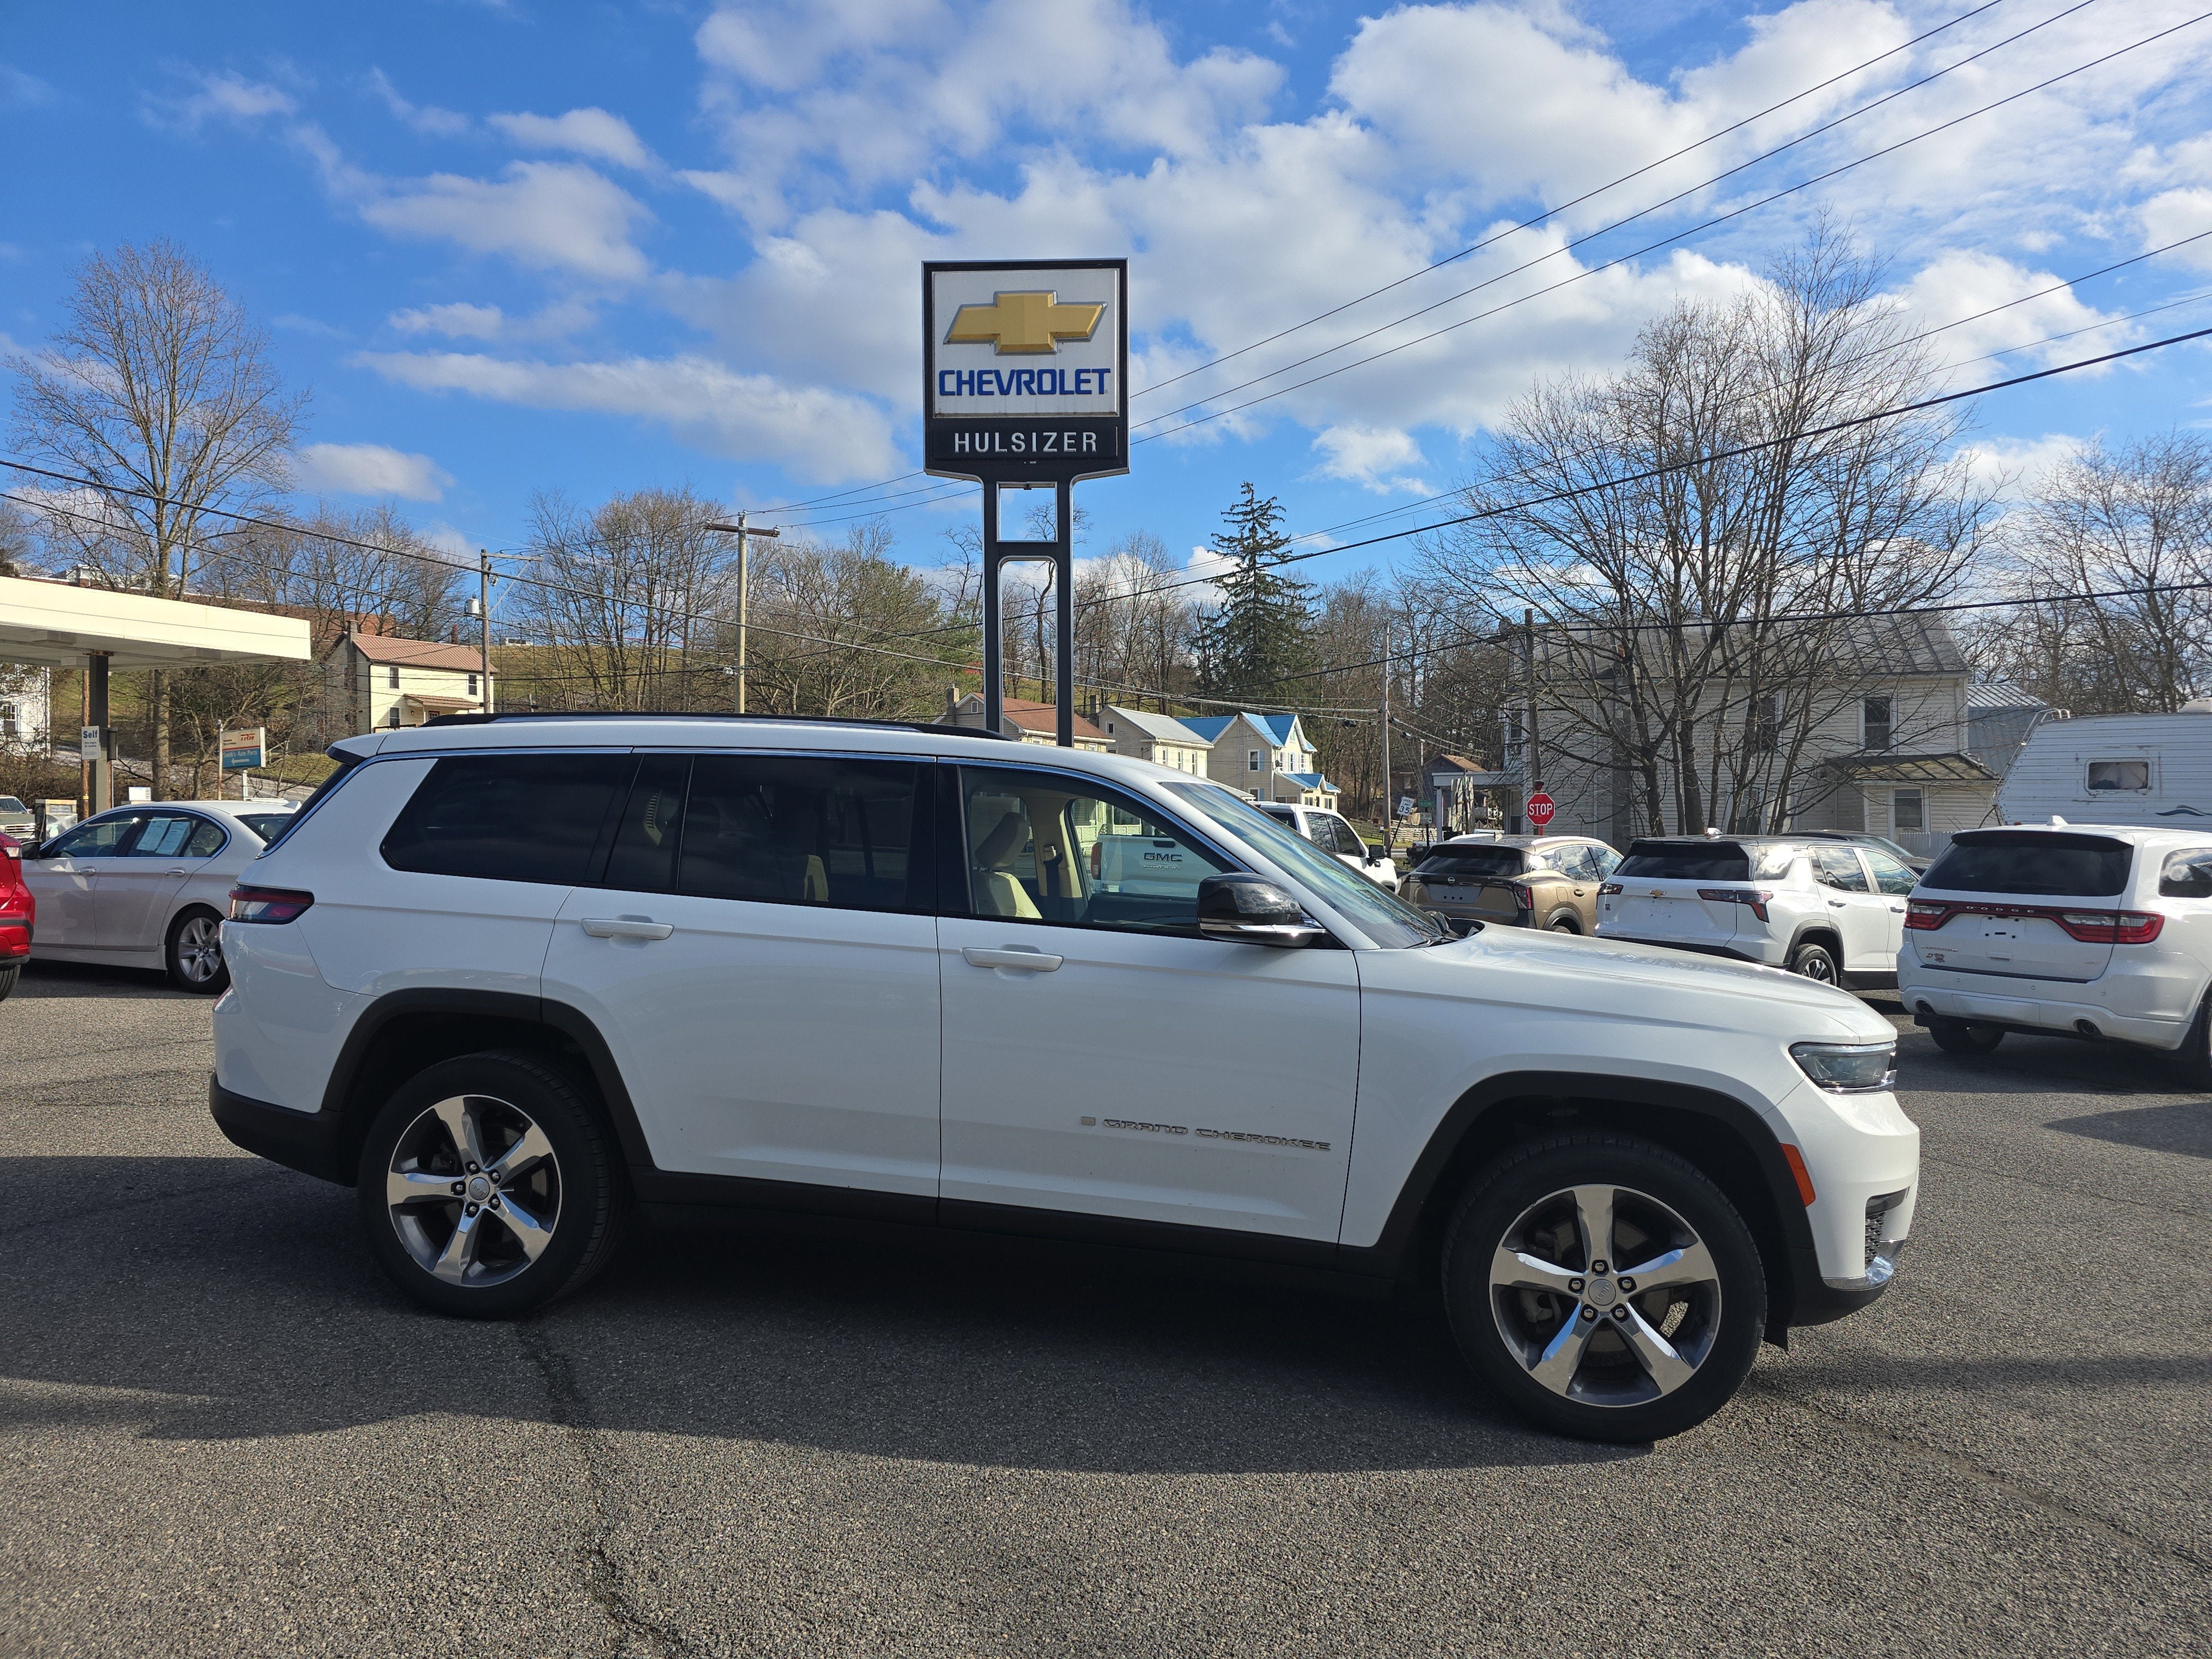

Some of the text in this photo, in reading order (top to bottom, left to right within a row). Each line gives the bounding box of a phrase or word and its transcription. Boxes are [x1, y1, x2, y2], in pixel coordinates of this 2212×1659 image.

[938, 368, 1111, 396] CHEVROLET
[954, 432, 1097, 453] HULSIZER
[83, 730, 98, 738] Self
[1399, 805, 1410, 814] 35
[1528, 803, 1553, 815] STOP
[1143, 853, 1182, 862] GMC
[1103, 1118, 1332, 1152] GRAND CHEROKEE
